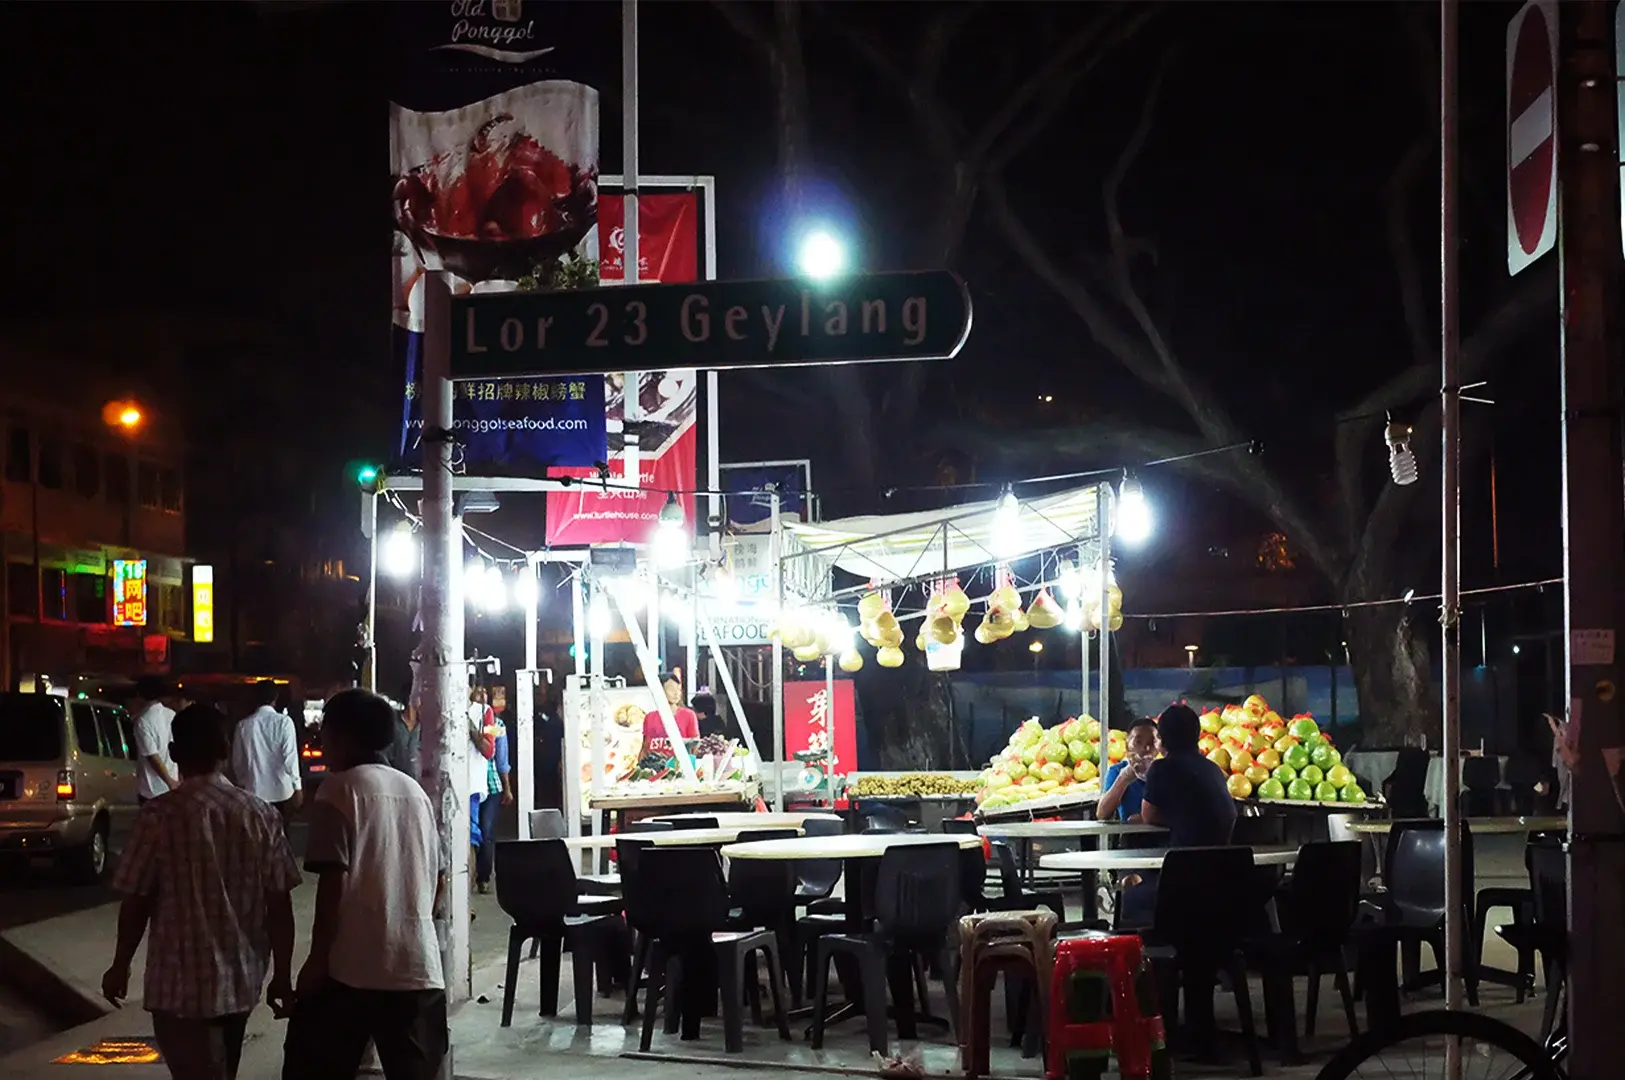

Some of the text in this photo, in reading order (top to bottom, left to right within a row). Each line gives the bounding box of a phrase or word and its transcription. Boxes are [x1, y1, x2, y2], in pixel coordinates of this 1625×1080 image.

[451, 17, 535, 44] Ponggol
[465, 287, 928, 354] Lor 23 Geylang
